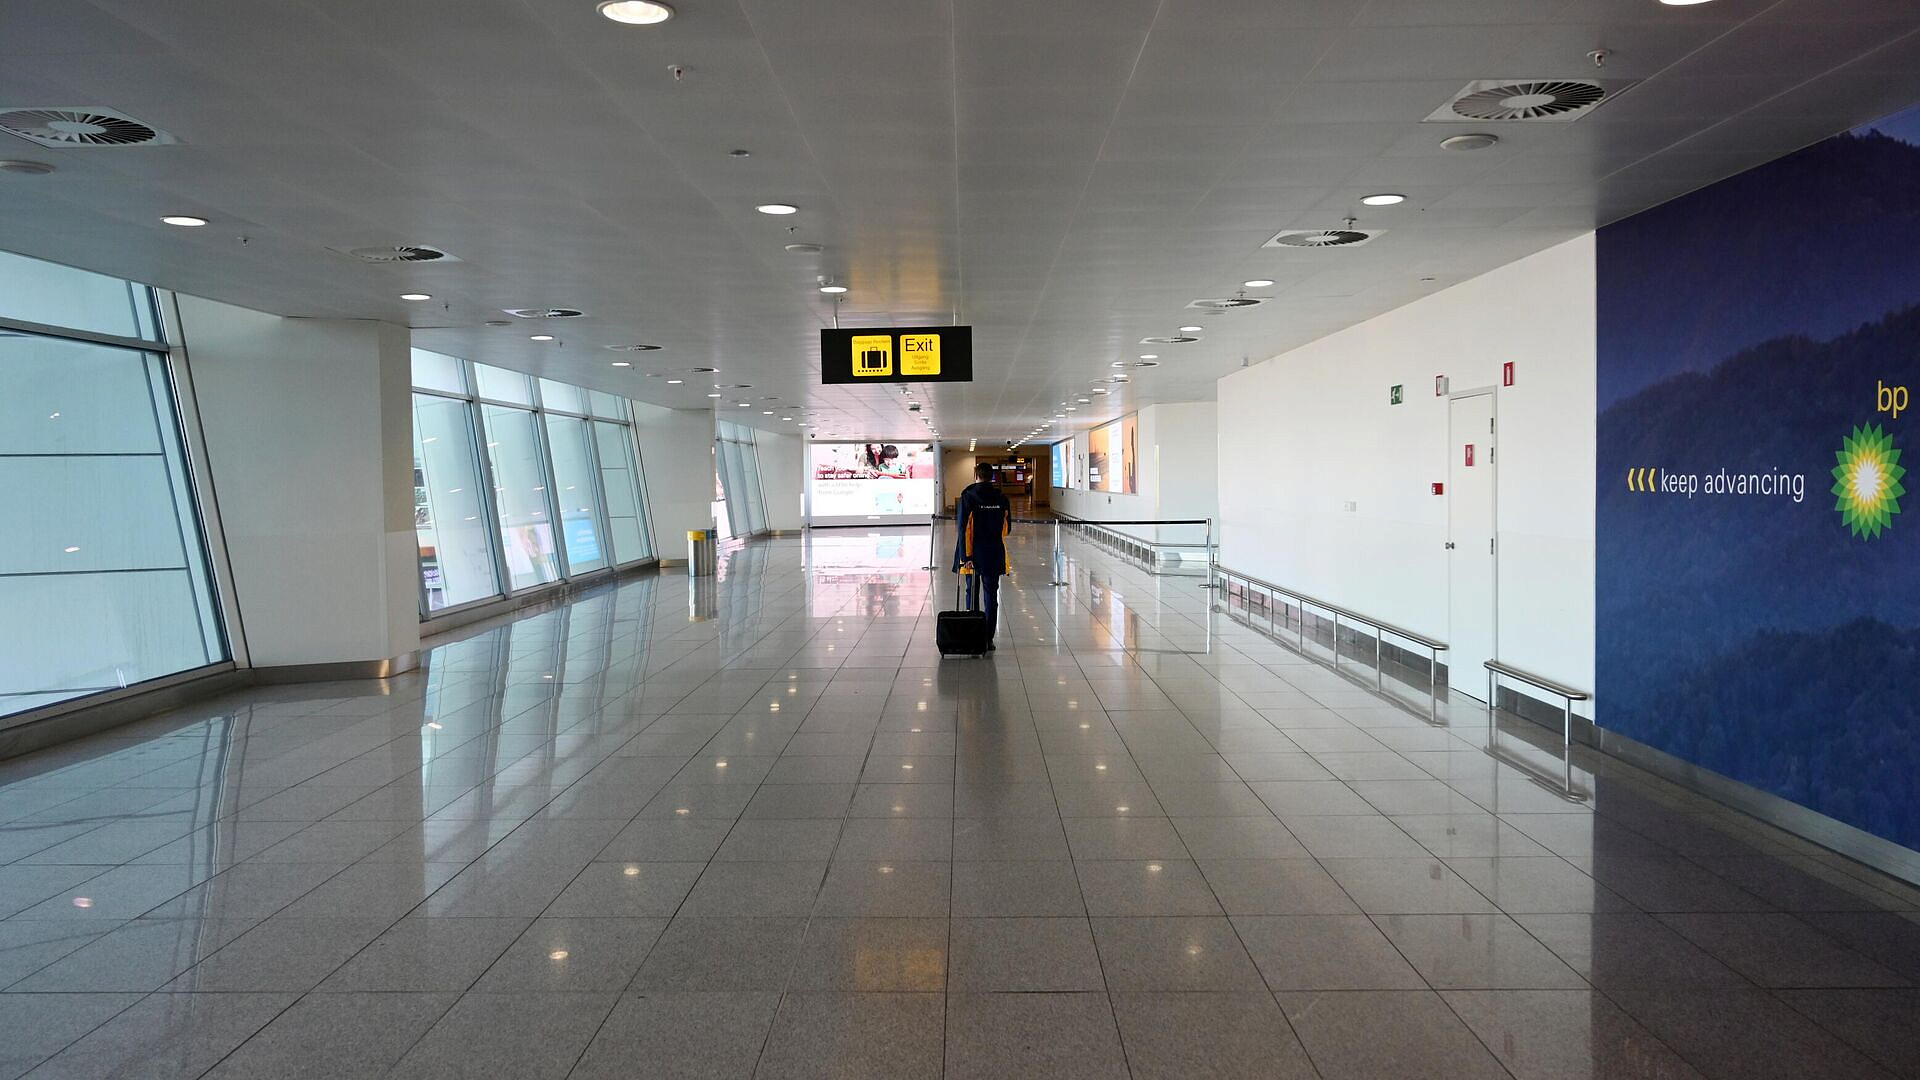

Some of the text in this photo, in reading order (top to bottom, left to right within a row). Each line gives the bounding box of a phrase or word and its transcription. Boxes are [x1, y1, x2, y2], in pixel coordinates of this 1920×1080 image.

[905, 337, 934, 352] Exit
[1877, 380, 1908, 419] bp
[1661, 467, 1805, 503] keep advancing
